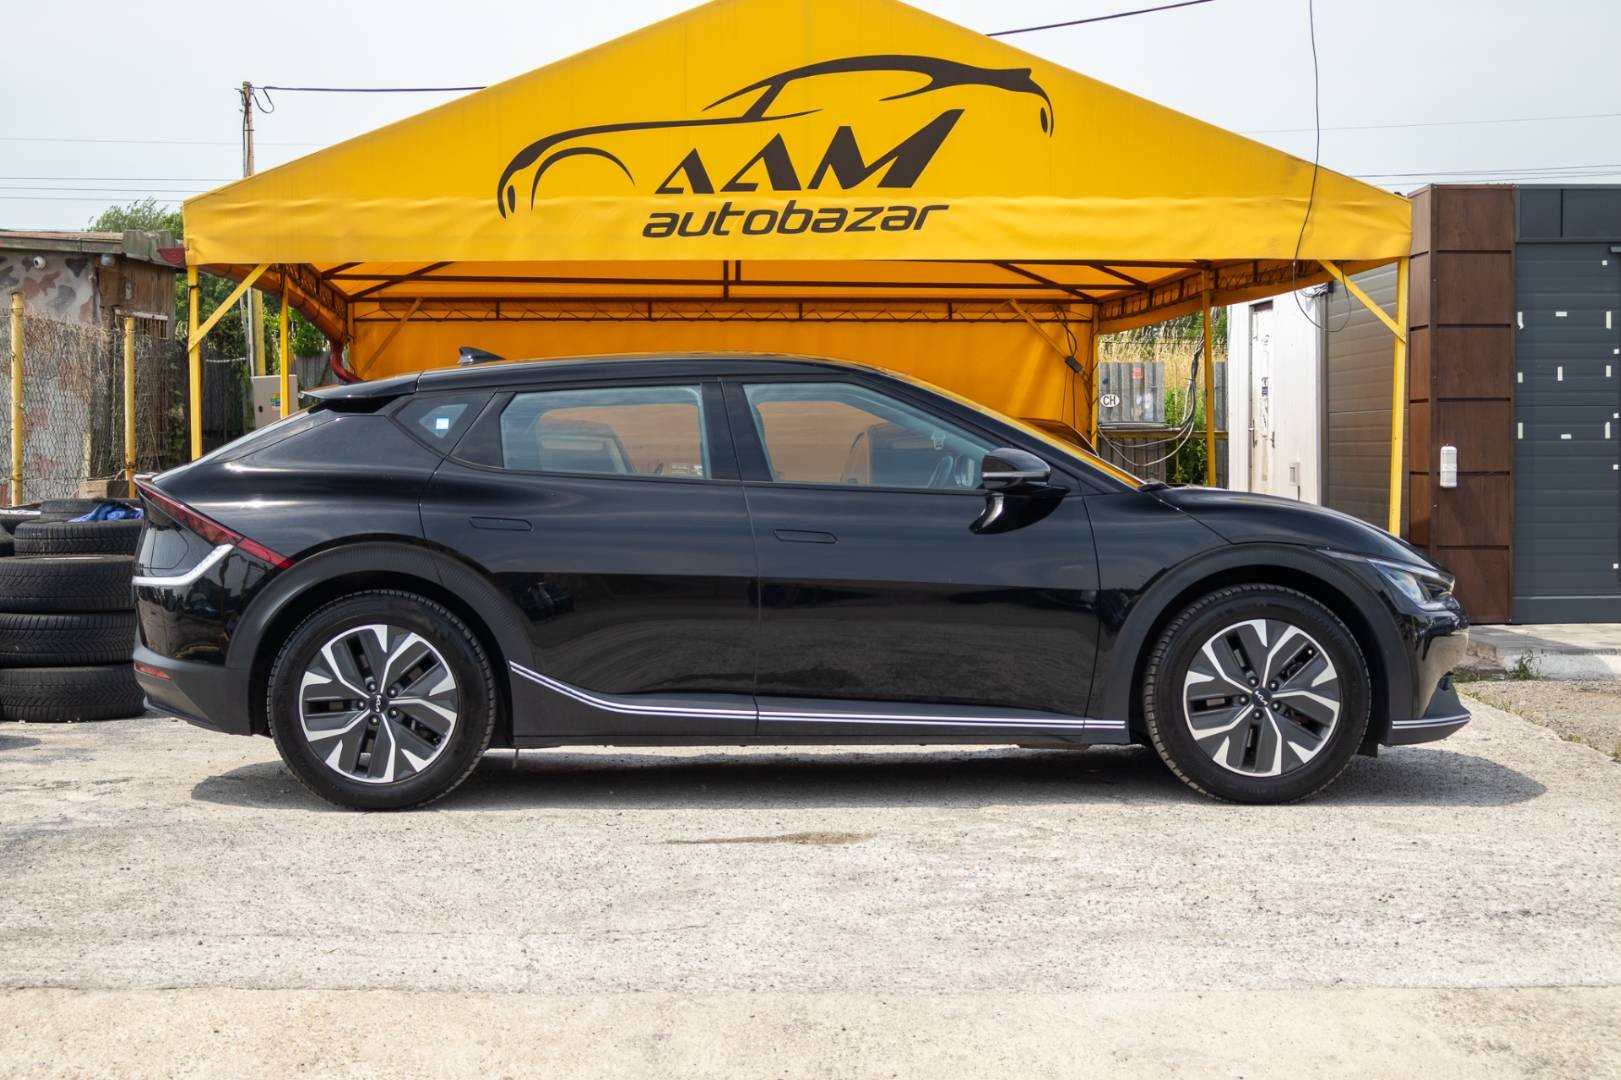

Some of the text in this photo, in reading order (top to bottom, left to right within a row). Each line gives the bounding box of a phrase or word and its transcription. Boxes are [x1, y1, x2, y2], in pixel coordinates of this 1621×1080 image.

[654, 108, 965, 195] AAM
[642, 200, 950, 238] autobazar
[1102, 395, 1116, 405] CH
